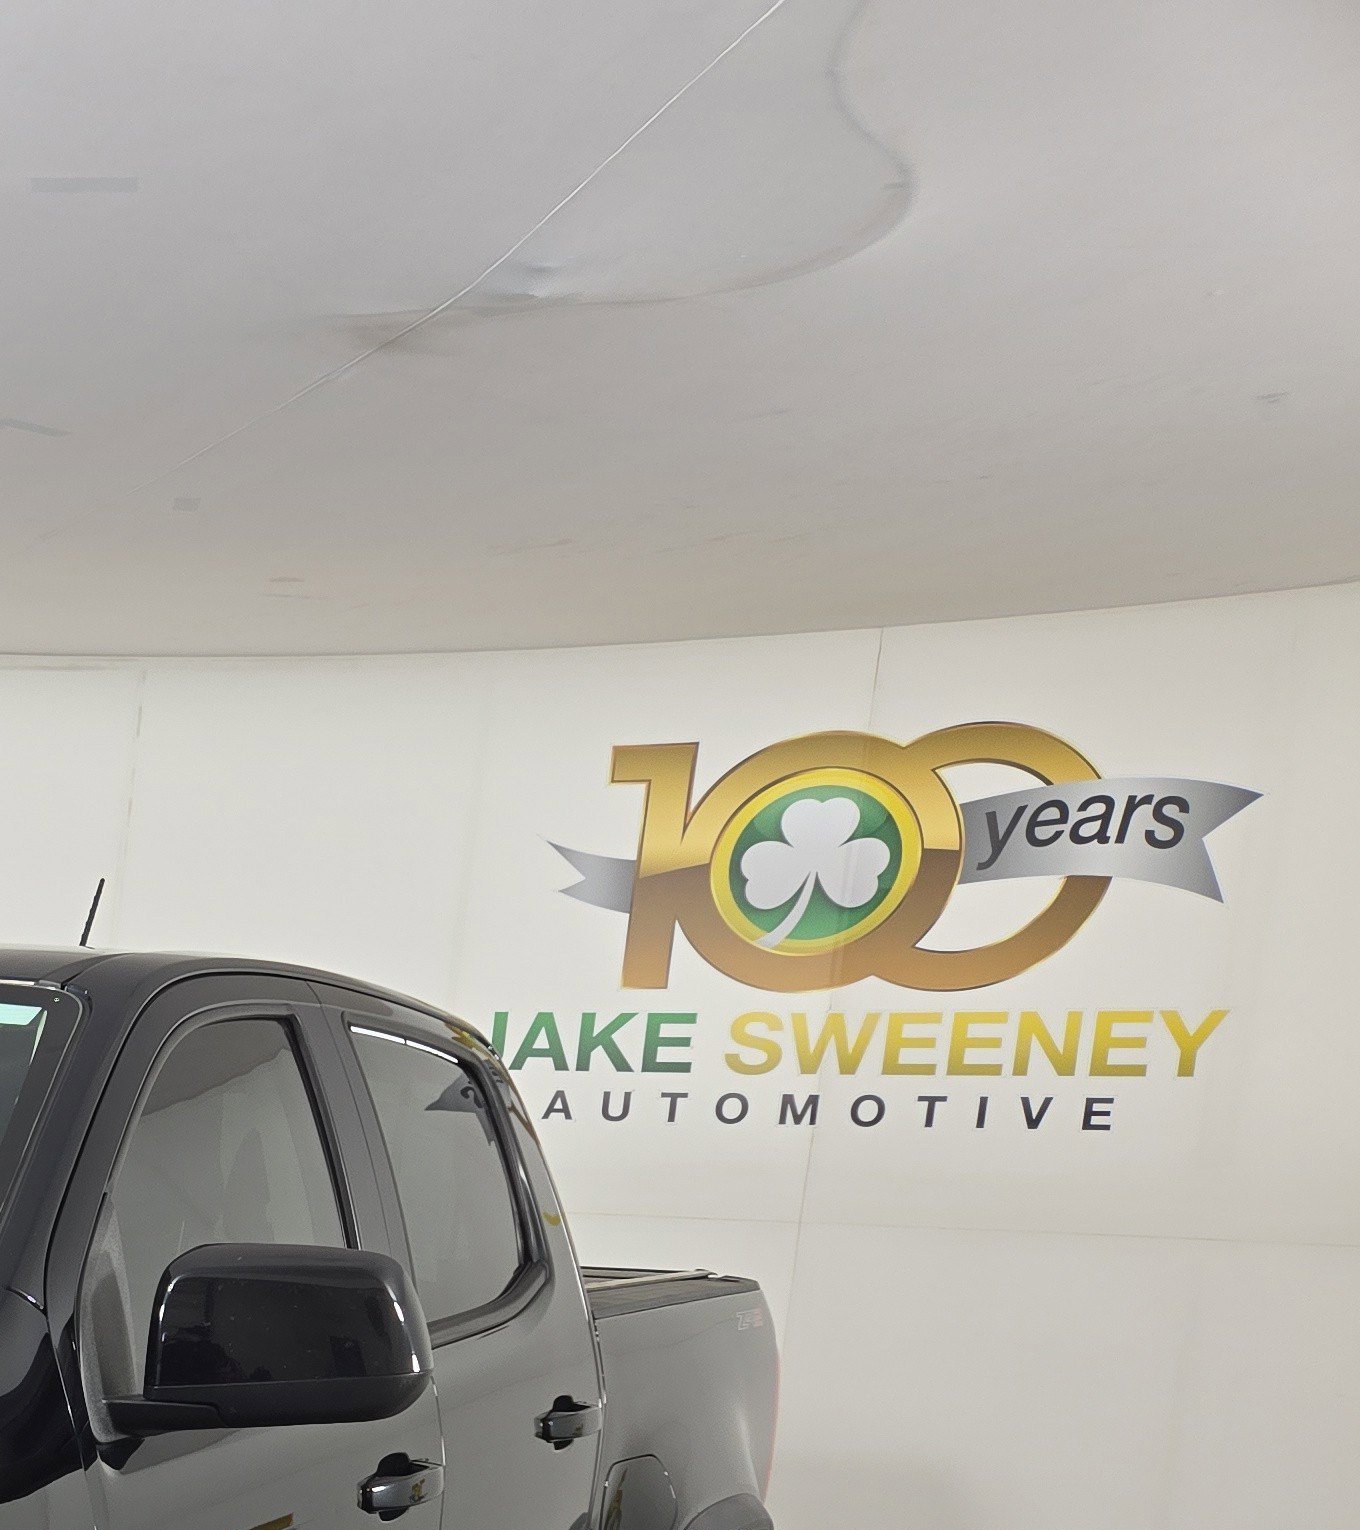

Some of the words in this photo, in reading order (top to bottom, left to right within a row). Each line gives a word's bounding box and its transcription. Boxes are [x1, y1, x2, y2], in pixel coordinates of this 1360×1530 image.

[610, 721, 1112, 993] 100
[976, 791, 1190, 871] years
[491, 1010, 698, 1074] JAKE
[723, 1009, 1230, 1079] SWEENEY
[541, 1089, 1116, 1132] AUTOMOTIVE
